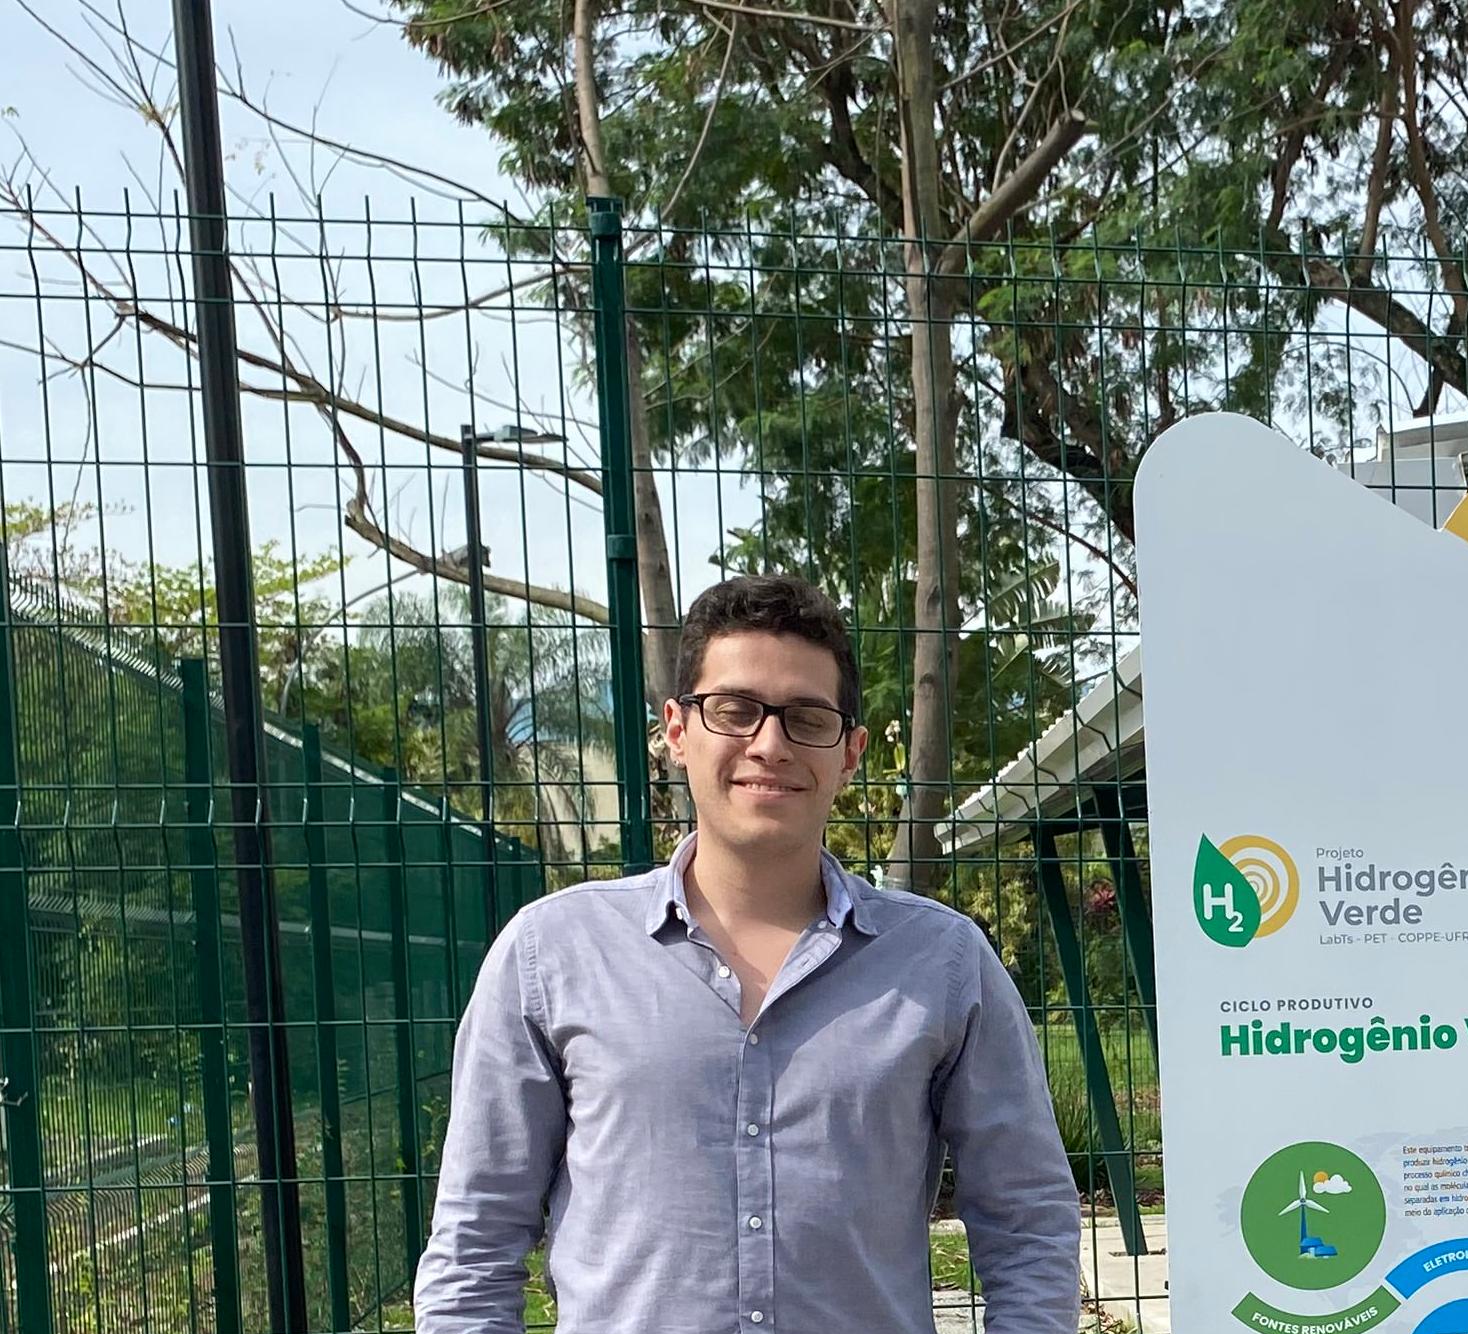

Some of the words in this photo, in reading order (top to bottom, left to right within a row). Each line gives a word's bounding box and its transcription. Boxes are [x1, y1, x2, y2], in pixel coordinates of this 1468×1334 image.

[1316, 847, 1364, 861] Projeto
[1202, 882, 1244, 933] H2
[1319, 898, 1423, 926] Verde
[1320, 934, 1353, 945] LabTs
[1364, 933, 1387, 944] PET
[1220, 999, 1271, 1013] CICLO
[1277, 997, 1374, 1011] PRODUTIVO
[1220, 1014, 1457, 1063] Hidrogênio
[1252, 1312, 1299, 1334] FONTES
